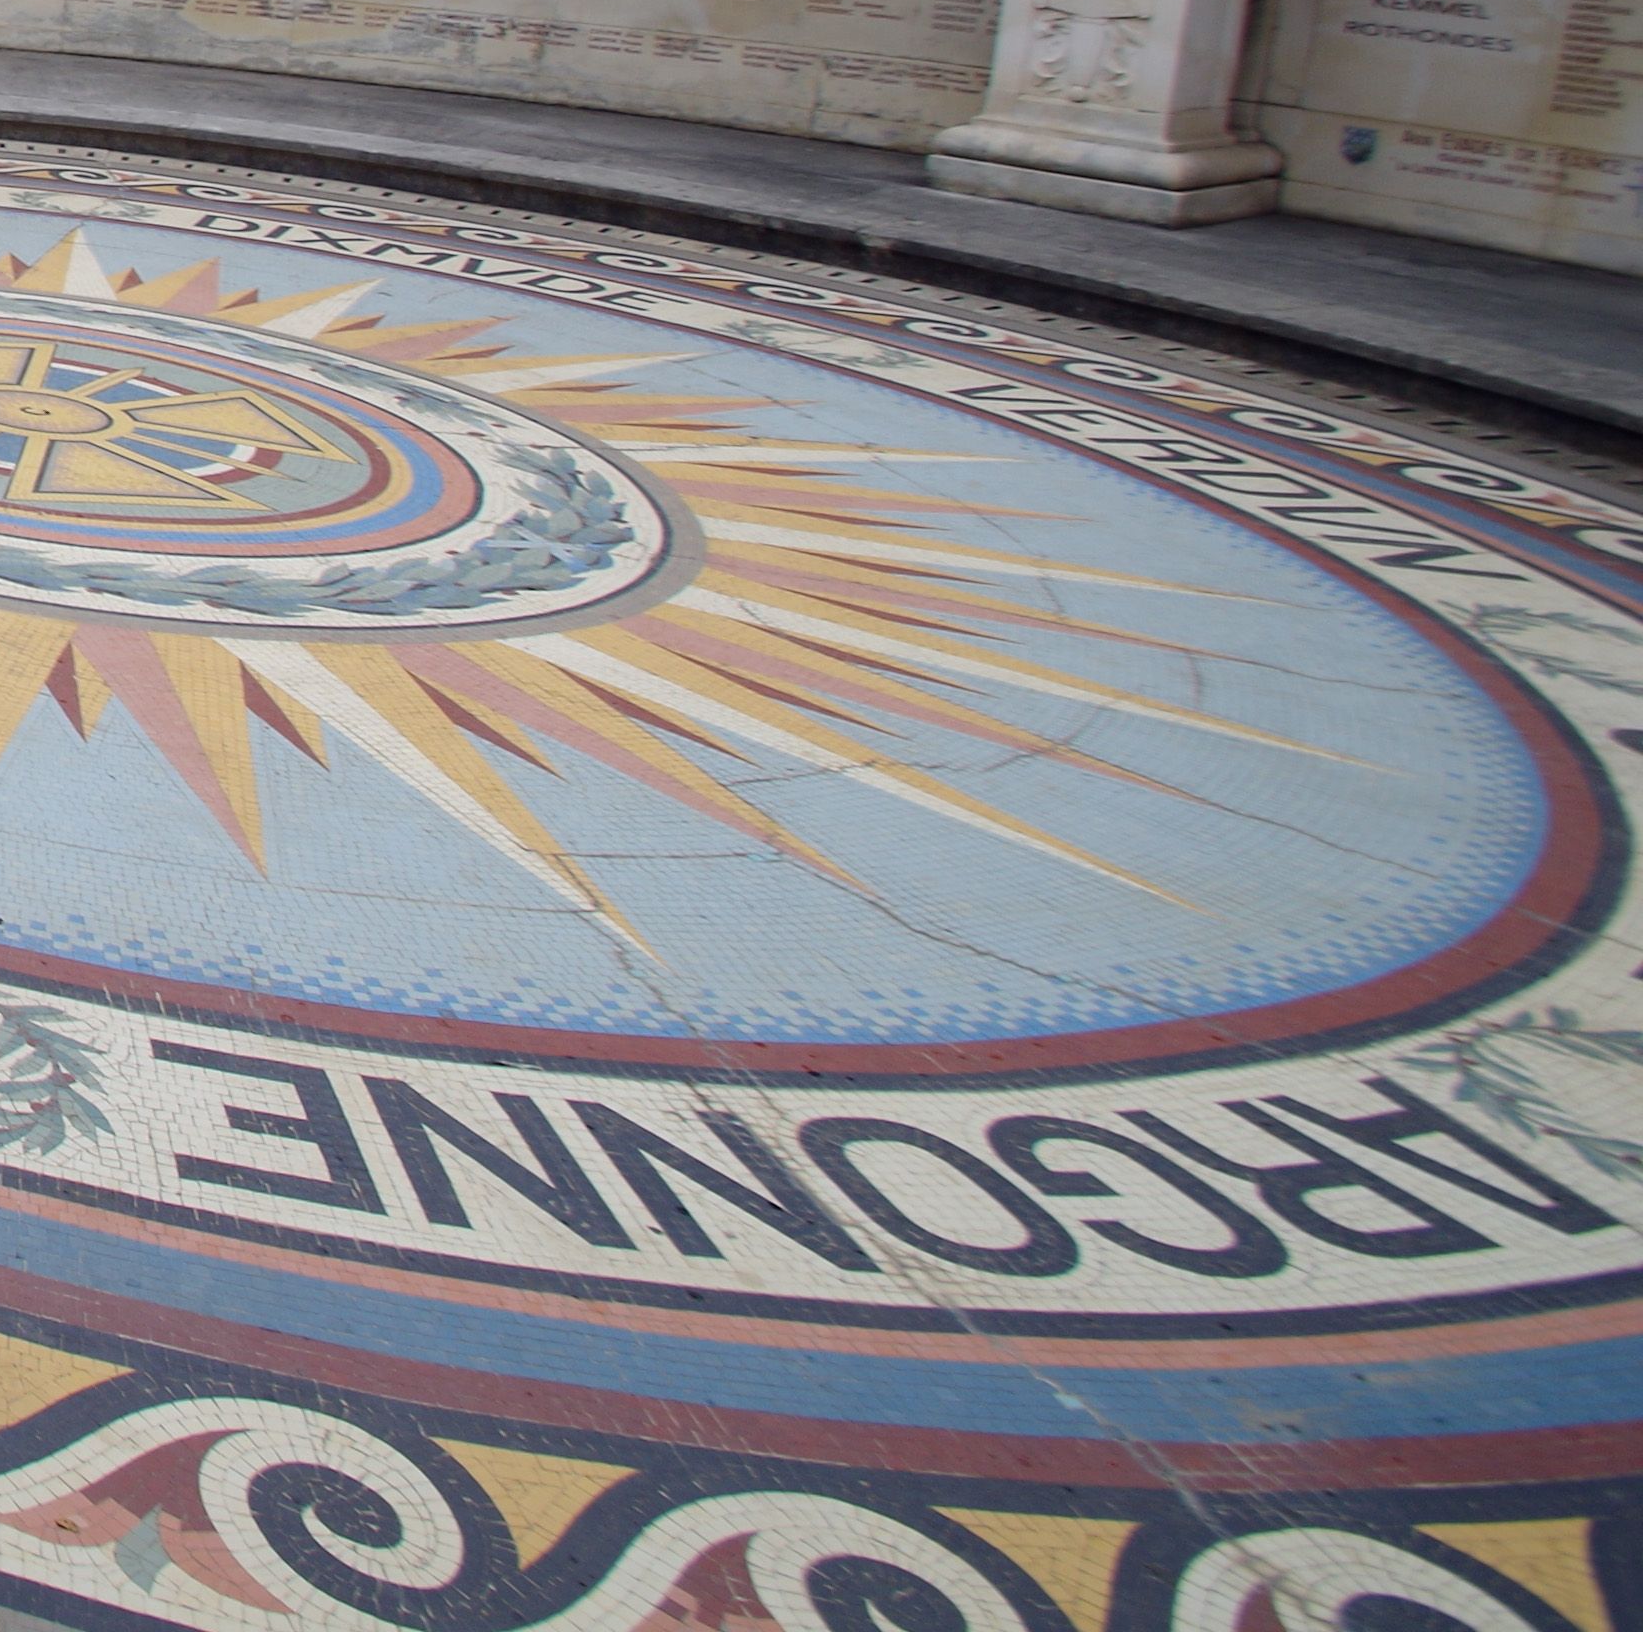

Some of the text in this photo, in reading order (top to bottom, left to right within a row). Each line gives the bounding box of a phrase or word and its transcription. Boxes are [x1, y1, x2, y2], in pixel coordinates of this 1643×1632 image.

[1343, 20, 1515, 53] ROTHONDES
[193, 213, 693, 312] DIXMVDE
[950, 383, 1532, 583] VERDUN
[151, 1039, 1625, 1278] ARGONNE
